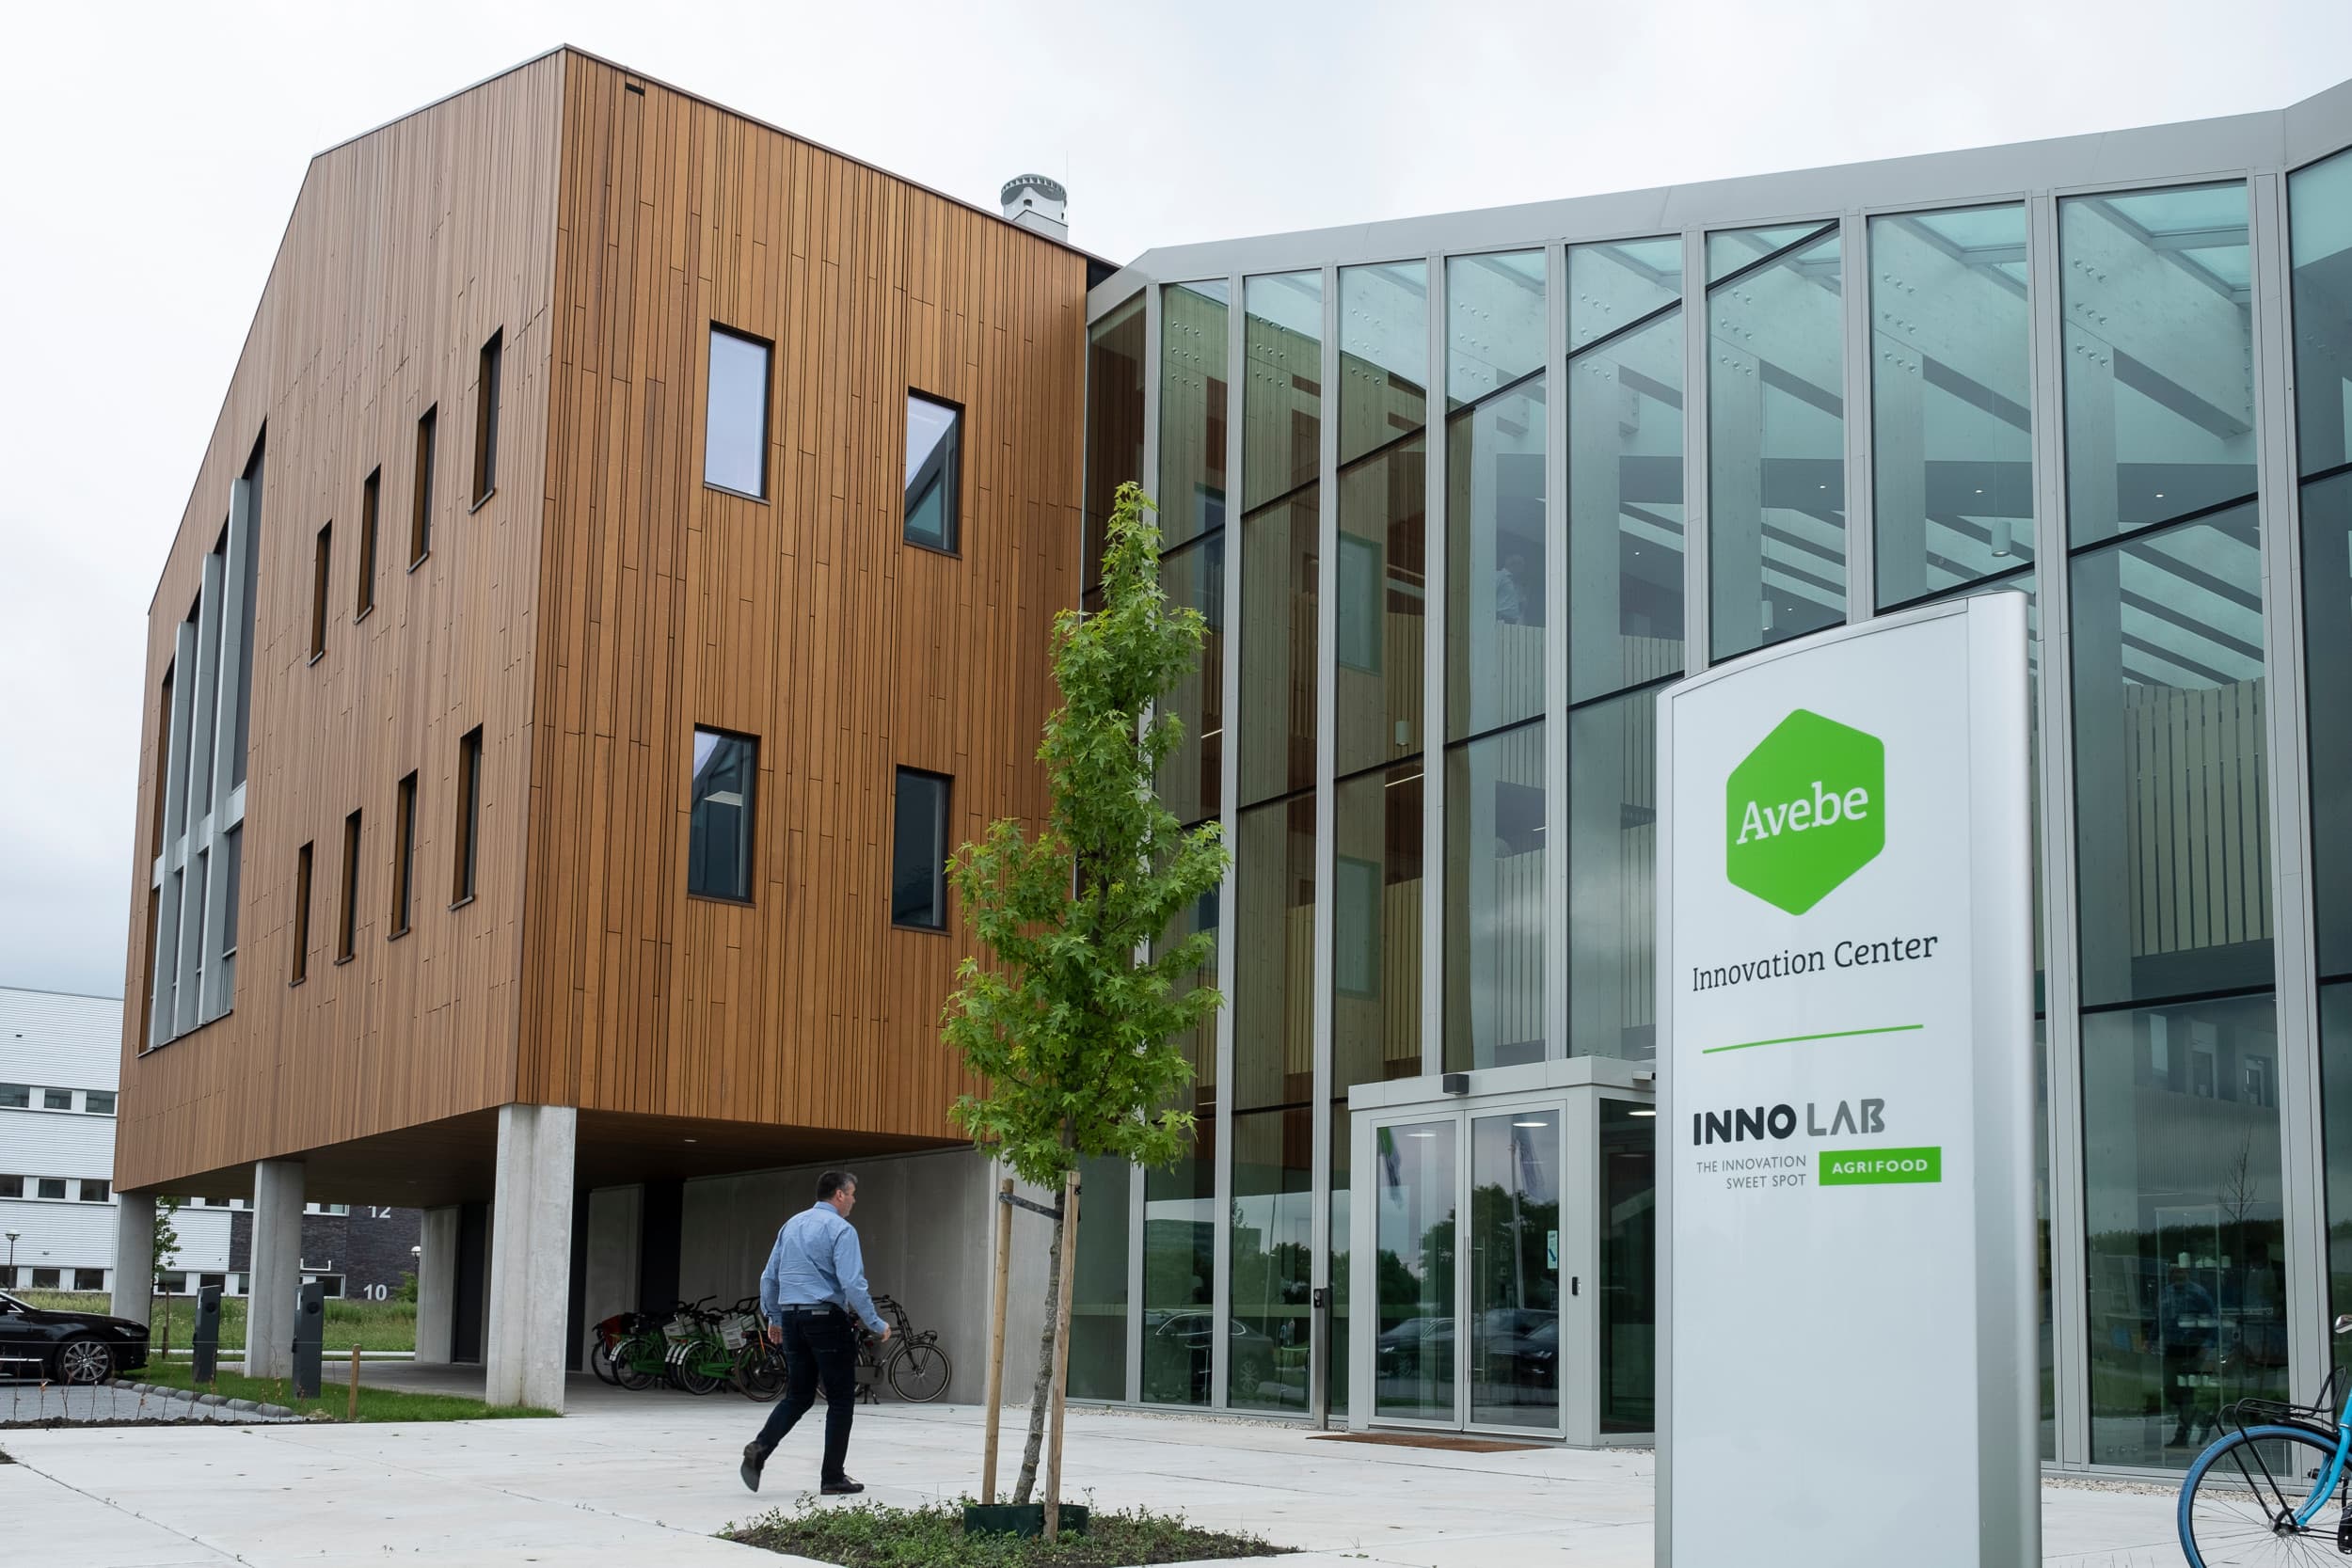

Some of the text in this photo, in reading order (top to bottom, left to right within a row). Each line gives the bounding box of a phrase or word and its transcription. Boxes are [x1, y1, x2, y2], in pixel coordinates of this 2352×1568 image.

[1736, 781, 1869, 845] Avebe
[1692, 936, 1939, 992] Innovation Center
[1696, 1154, 1806, 1174] THE INNOVATION
[1832, 1159, 1928, 1175] AGRIFOOD
[1725, 1173, 1807, 1190] SWEET SPOT
[368, 1206, 391, 1219] 12
[363, 1283, 388, 1302] 10
